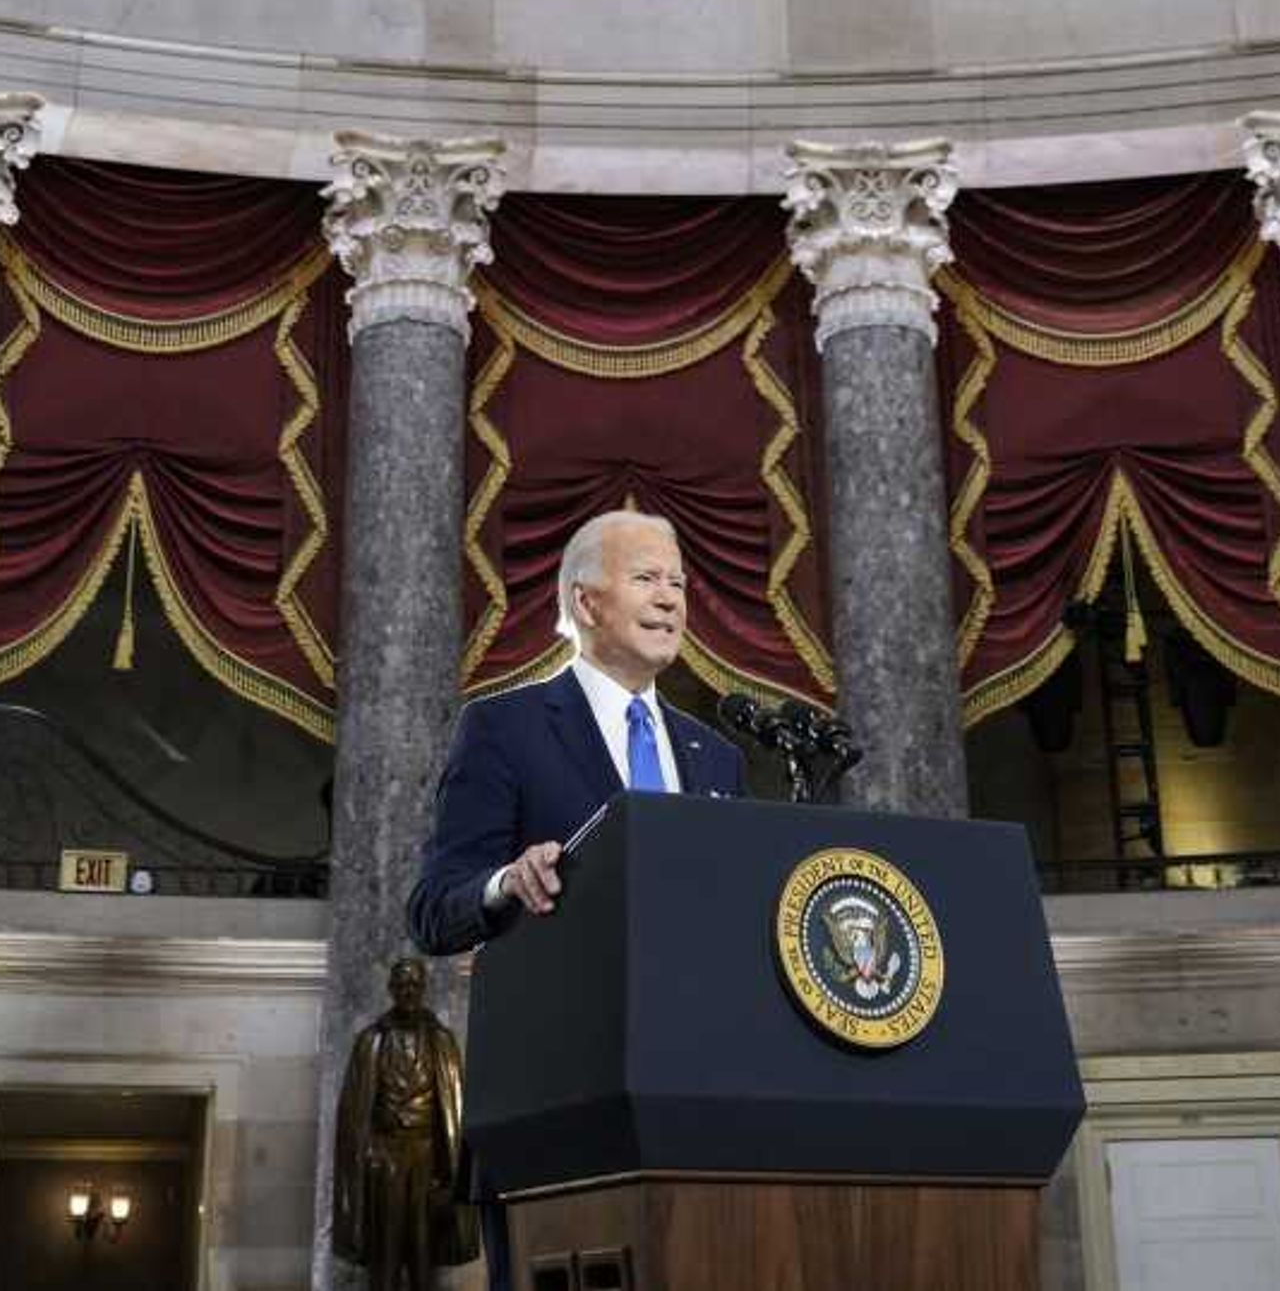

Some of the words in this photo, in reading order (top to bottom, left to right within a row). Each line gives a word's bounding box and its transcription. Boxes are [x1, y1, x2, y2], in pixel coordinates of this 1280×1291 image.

[75, 857, 112, 887] EXIT
[784, 857, 842, 937] PRESIDENT
[894, 881, 936, 959] UNITED
[815, 993, 860, 1036] SEAL
[887, 978, 936, 1034] STATES
